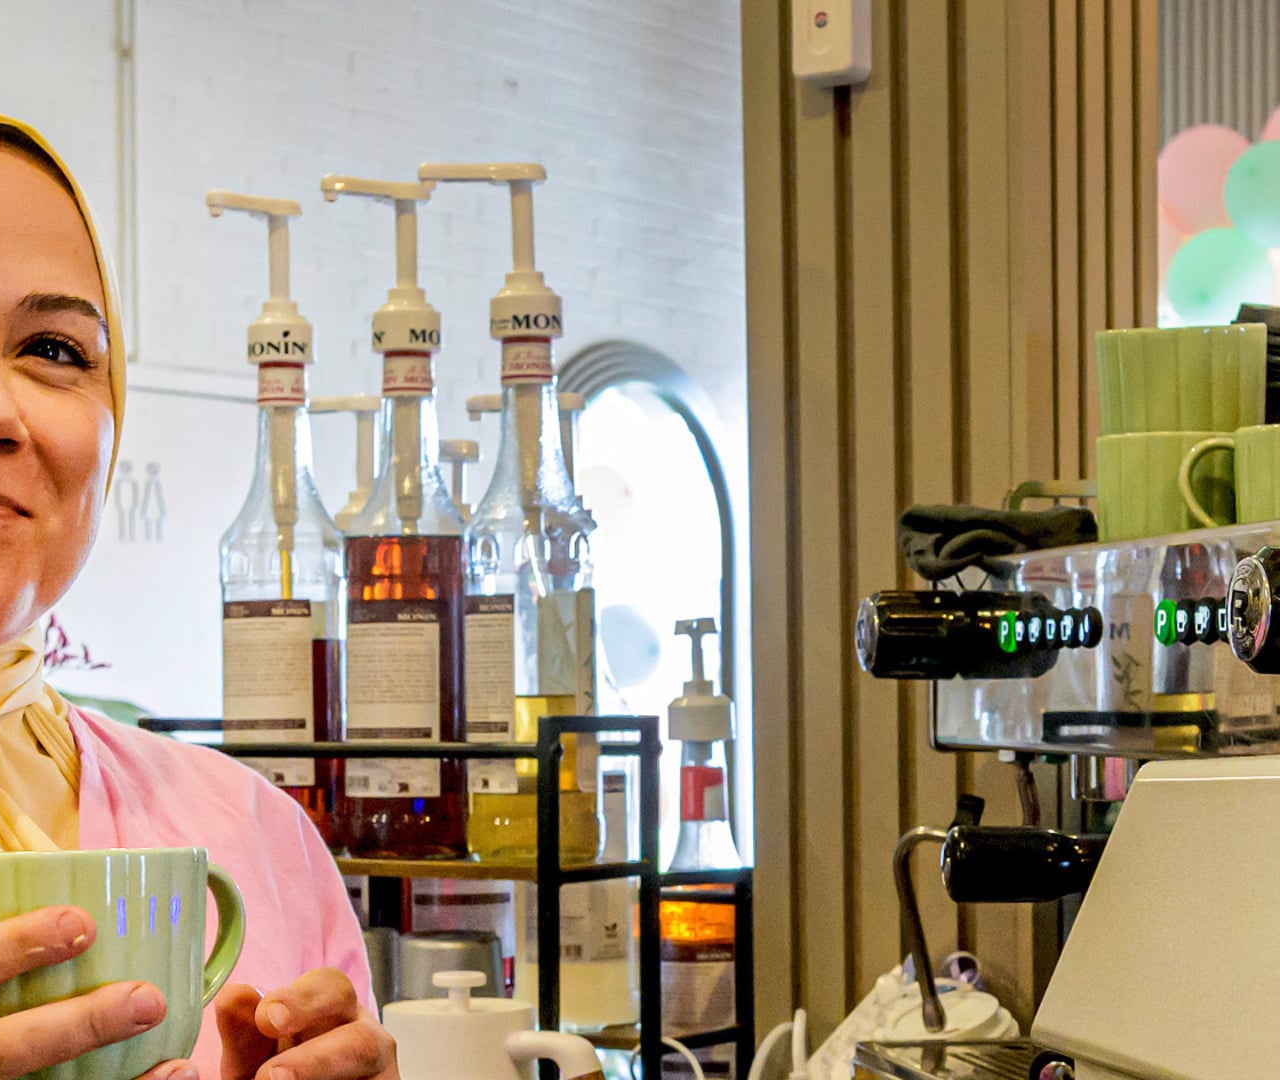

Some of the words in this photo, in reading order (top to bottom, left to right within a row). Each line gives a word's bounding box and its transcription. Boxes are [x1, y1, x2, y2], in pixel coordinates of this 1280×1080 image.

[271, 606, 310, 617] MONIN
[397, 612, 437, 622] MONIN
[1157, 610, 1167, 635] P
[1001, 621, 1009, 643] P
